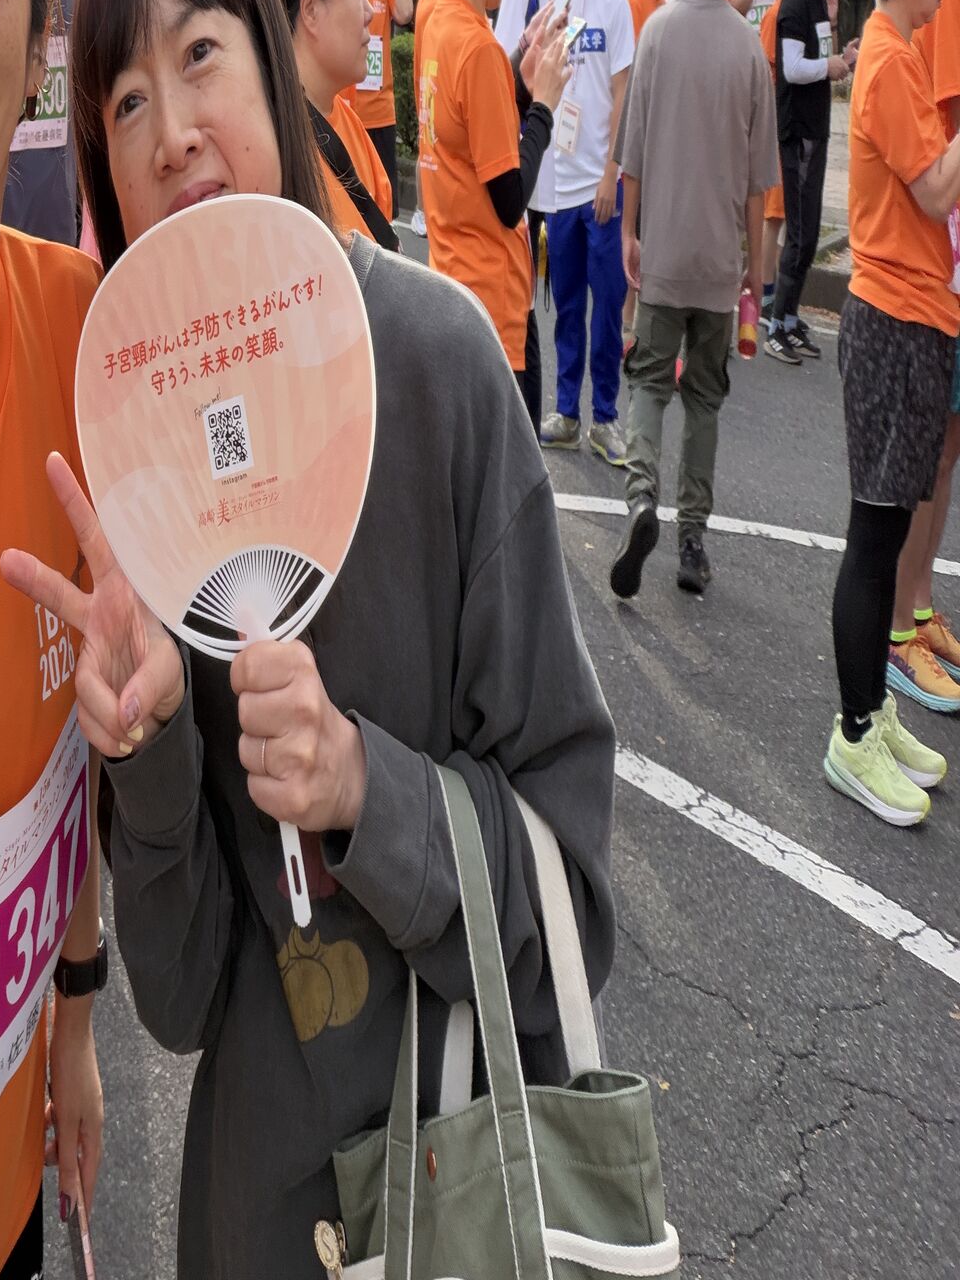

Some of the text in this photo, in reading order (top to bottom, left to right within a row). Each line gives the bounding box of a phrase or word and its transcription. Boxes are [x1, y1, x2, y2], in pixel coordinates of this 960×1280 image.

[367, 51, 382, 75] 25
[151, 326, 285, 396] 守ろう、未来の笑顔。
[193, 386, 222, 421] Follow me!
[34, 603, 65, 649] TB
[40, 627, 75, 701] 2026
